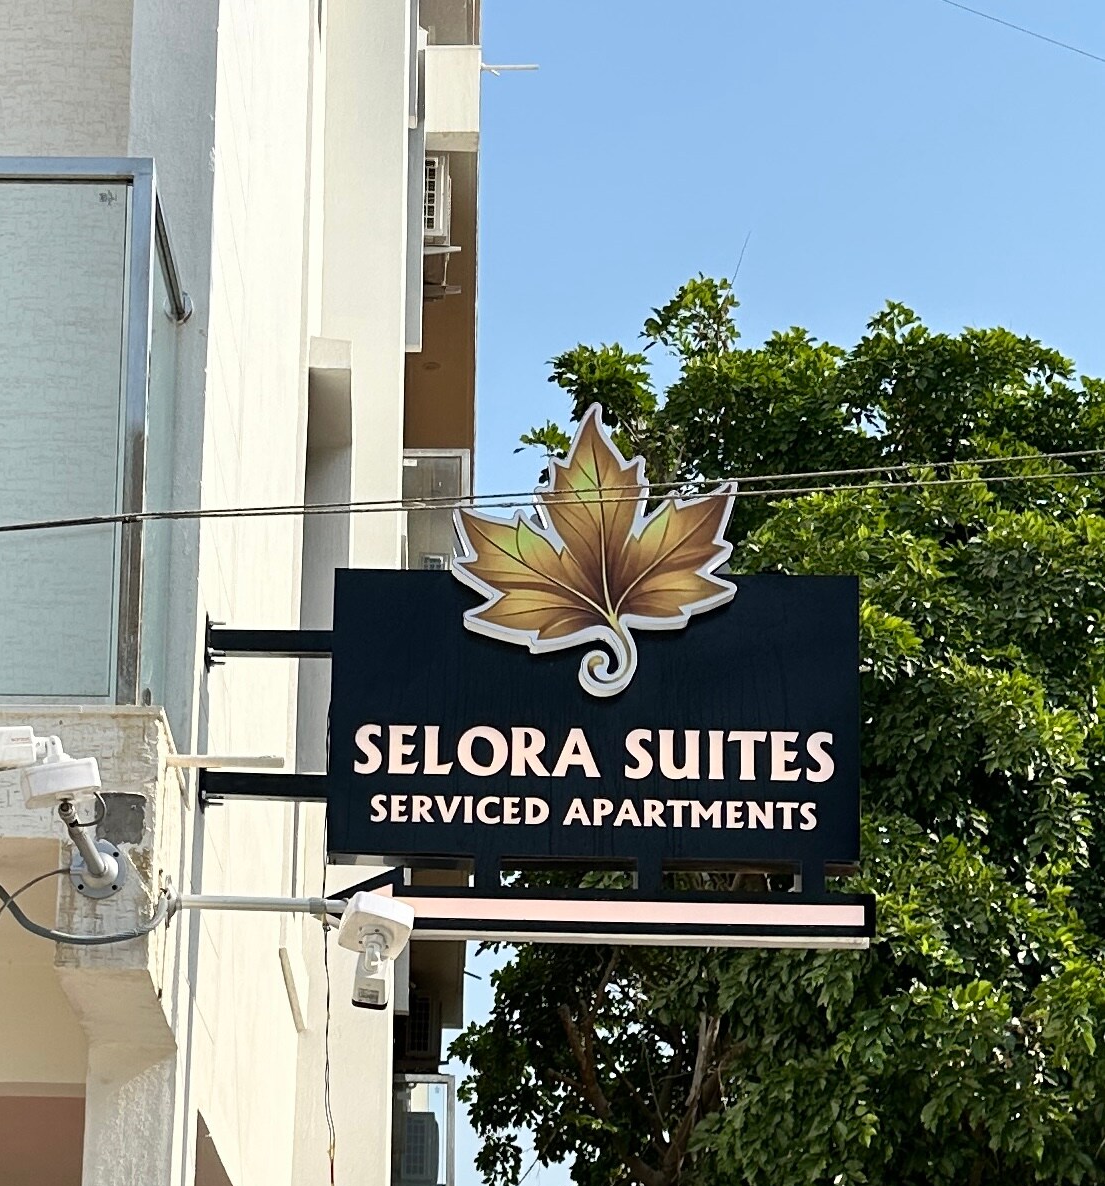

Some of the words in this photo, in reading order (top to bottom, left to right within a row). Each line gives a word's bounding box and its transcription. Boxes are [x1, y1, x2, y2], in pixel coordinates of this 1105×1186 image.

[353, 724, 602, 778] SELORA
[624, 728, 835, 782] SUITES
[370, 794, 550, 825] SERVICED
[562, 798, 817, 831] APARTMENTS
